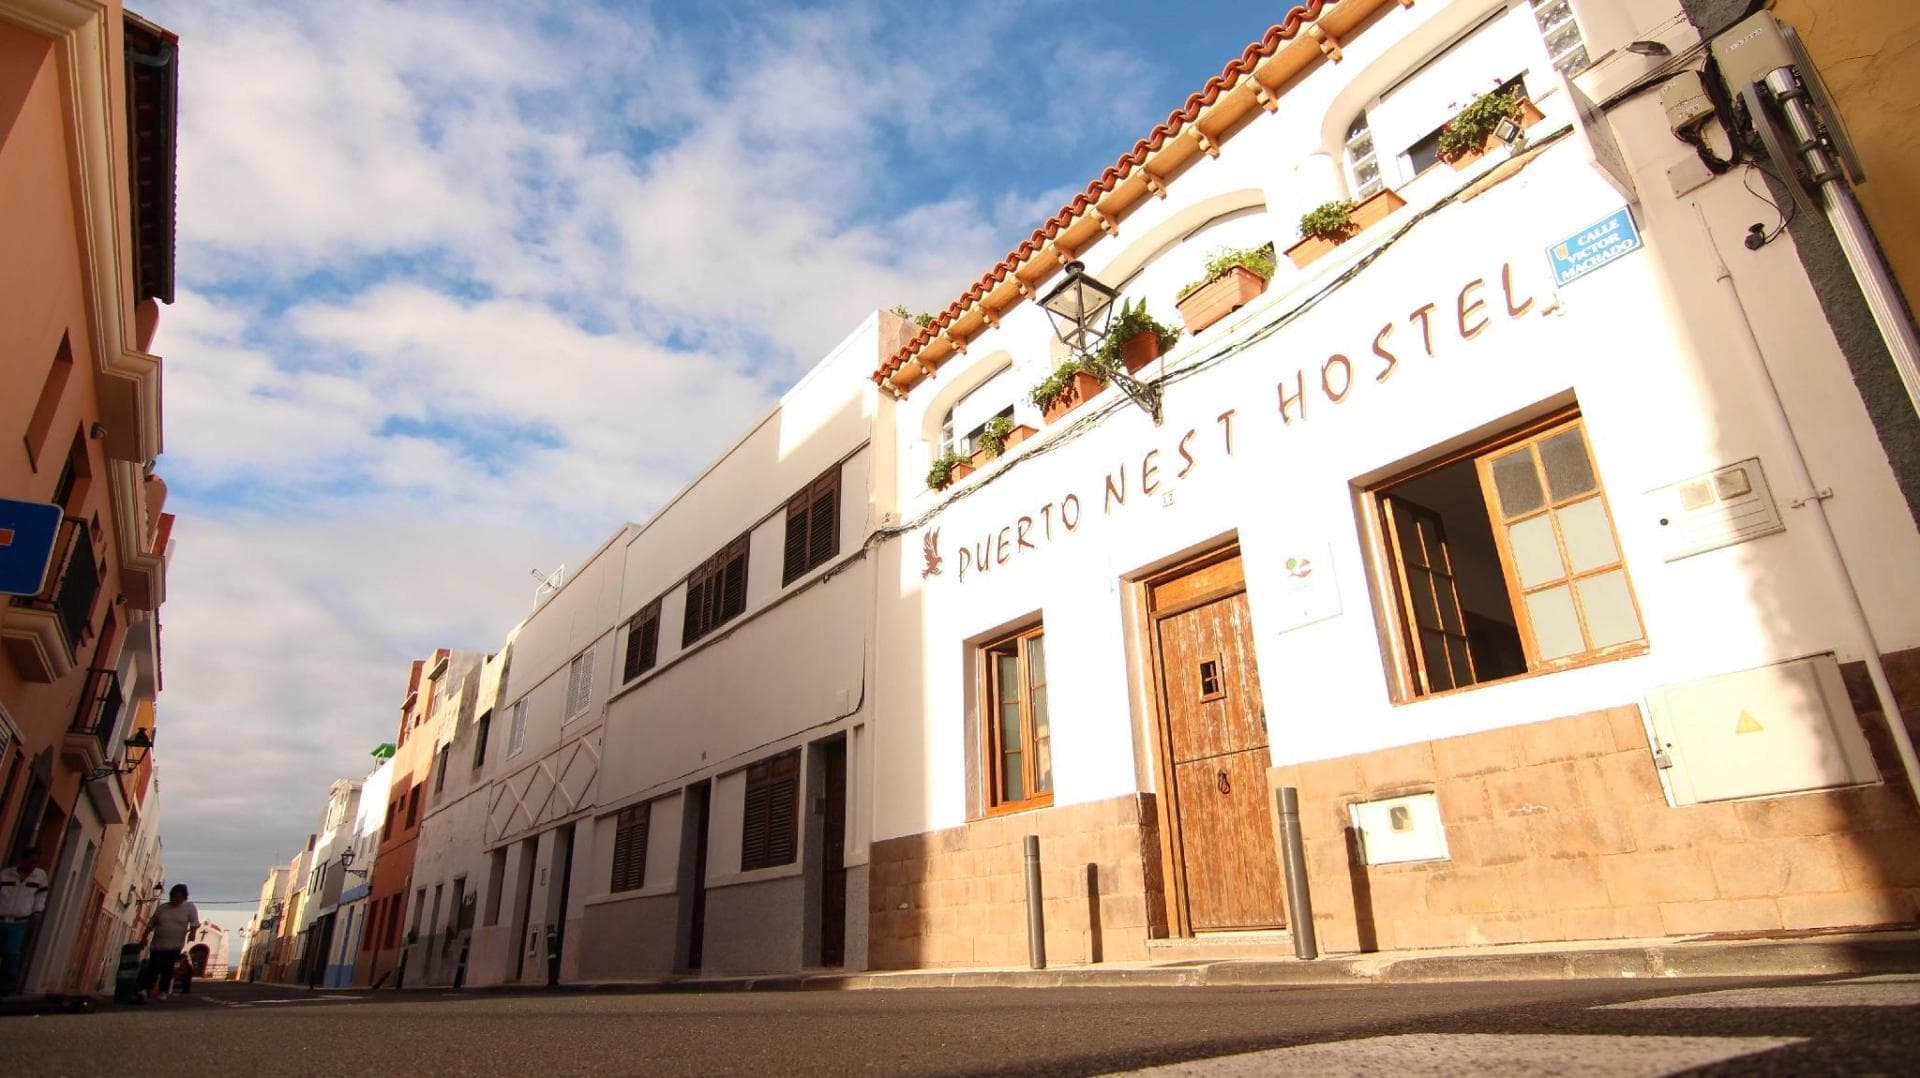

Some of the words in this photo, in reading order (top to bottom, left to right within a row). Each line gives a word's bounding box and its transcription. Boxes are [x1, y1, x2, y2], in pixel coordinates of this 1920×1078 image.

[1578, 219, 1620, 246] CALLE
[958, 493, 1080, 583] PUERTO
[1104, 408, 1237, 514] NEST
[1277, 262, 1534, 424] HOSTEL
